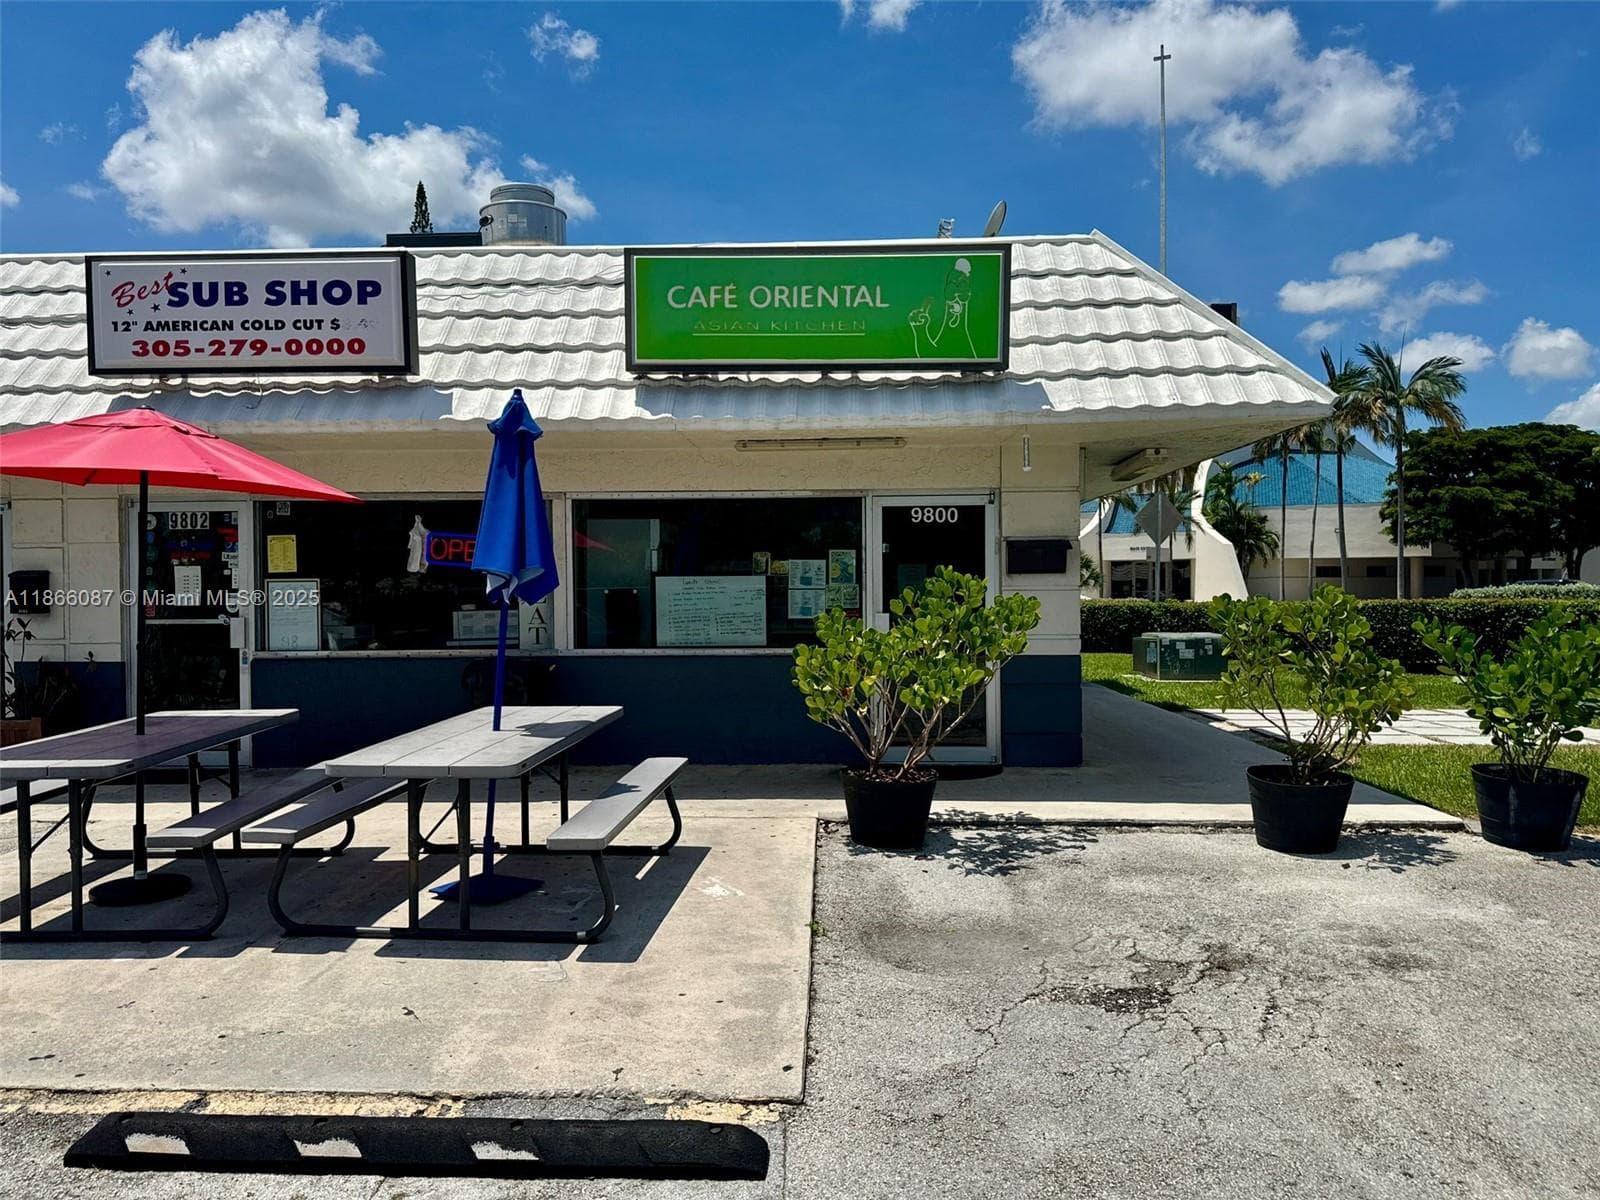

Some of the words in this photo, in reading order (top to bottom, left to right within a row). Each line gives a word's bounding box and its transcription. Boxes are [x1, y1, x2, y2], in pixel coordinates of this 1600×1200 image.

[111, 271, 174, 308] Best
[167, 281, 249, 308] SUB
[264, 279, 382, 306] SHOP
[667, 282, 738, 309] CAFÉ
[749, 285, 890, 308] ORIENTAL
[111, 320, 138, 332] 12"
[143, 319, 234, 332] AMERICAN
[240, 319, 286, 332] COLD
[292, 318, 325, 331] CUT
[694, 320, 760, 331] ASIAN
[770, 319, 866, 331] KITCHEN
[132, 338, 366, 358] 305-279-0000
[170, 512, 208, 529] 9802
[911, 507, 959, 523] 9800
[430, 537, 476, 562] OPE
